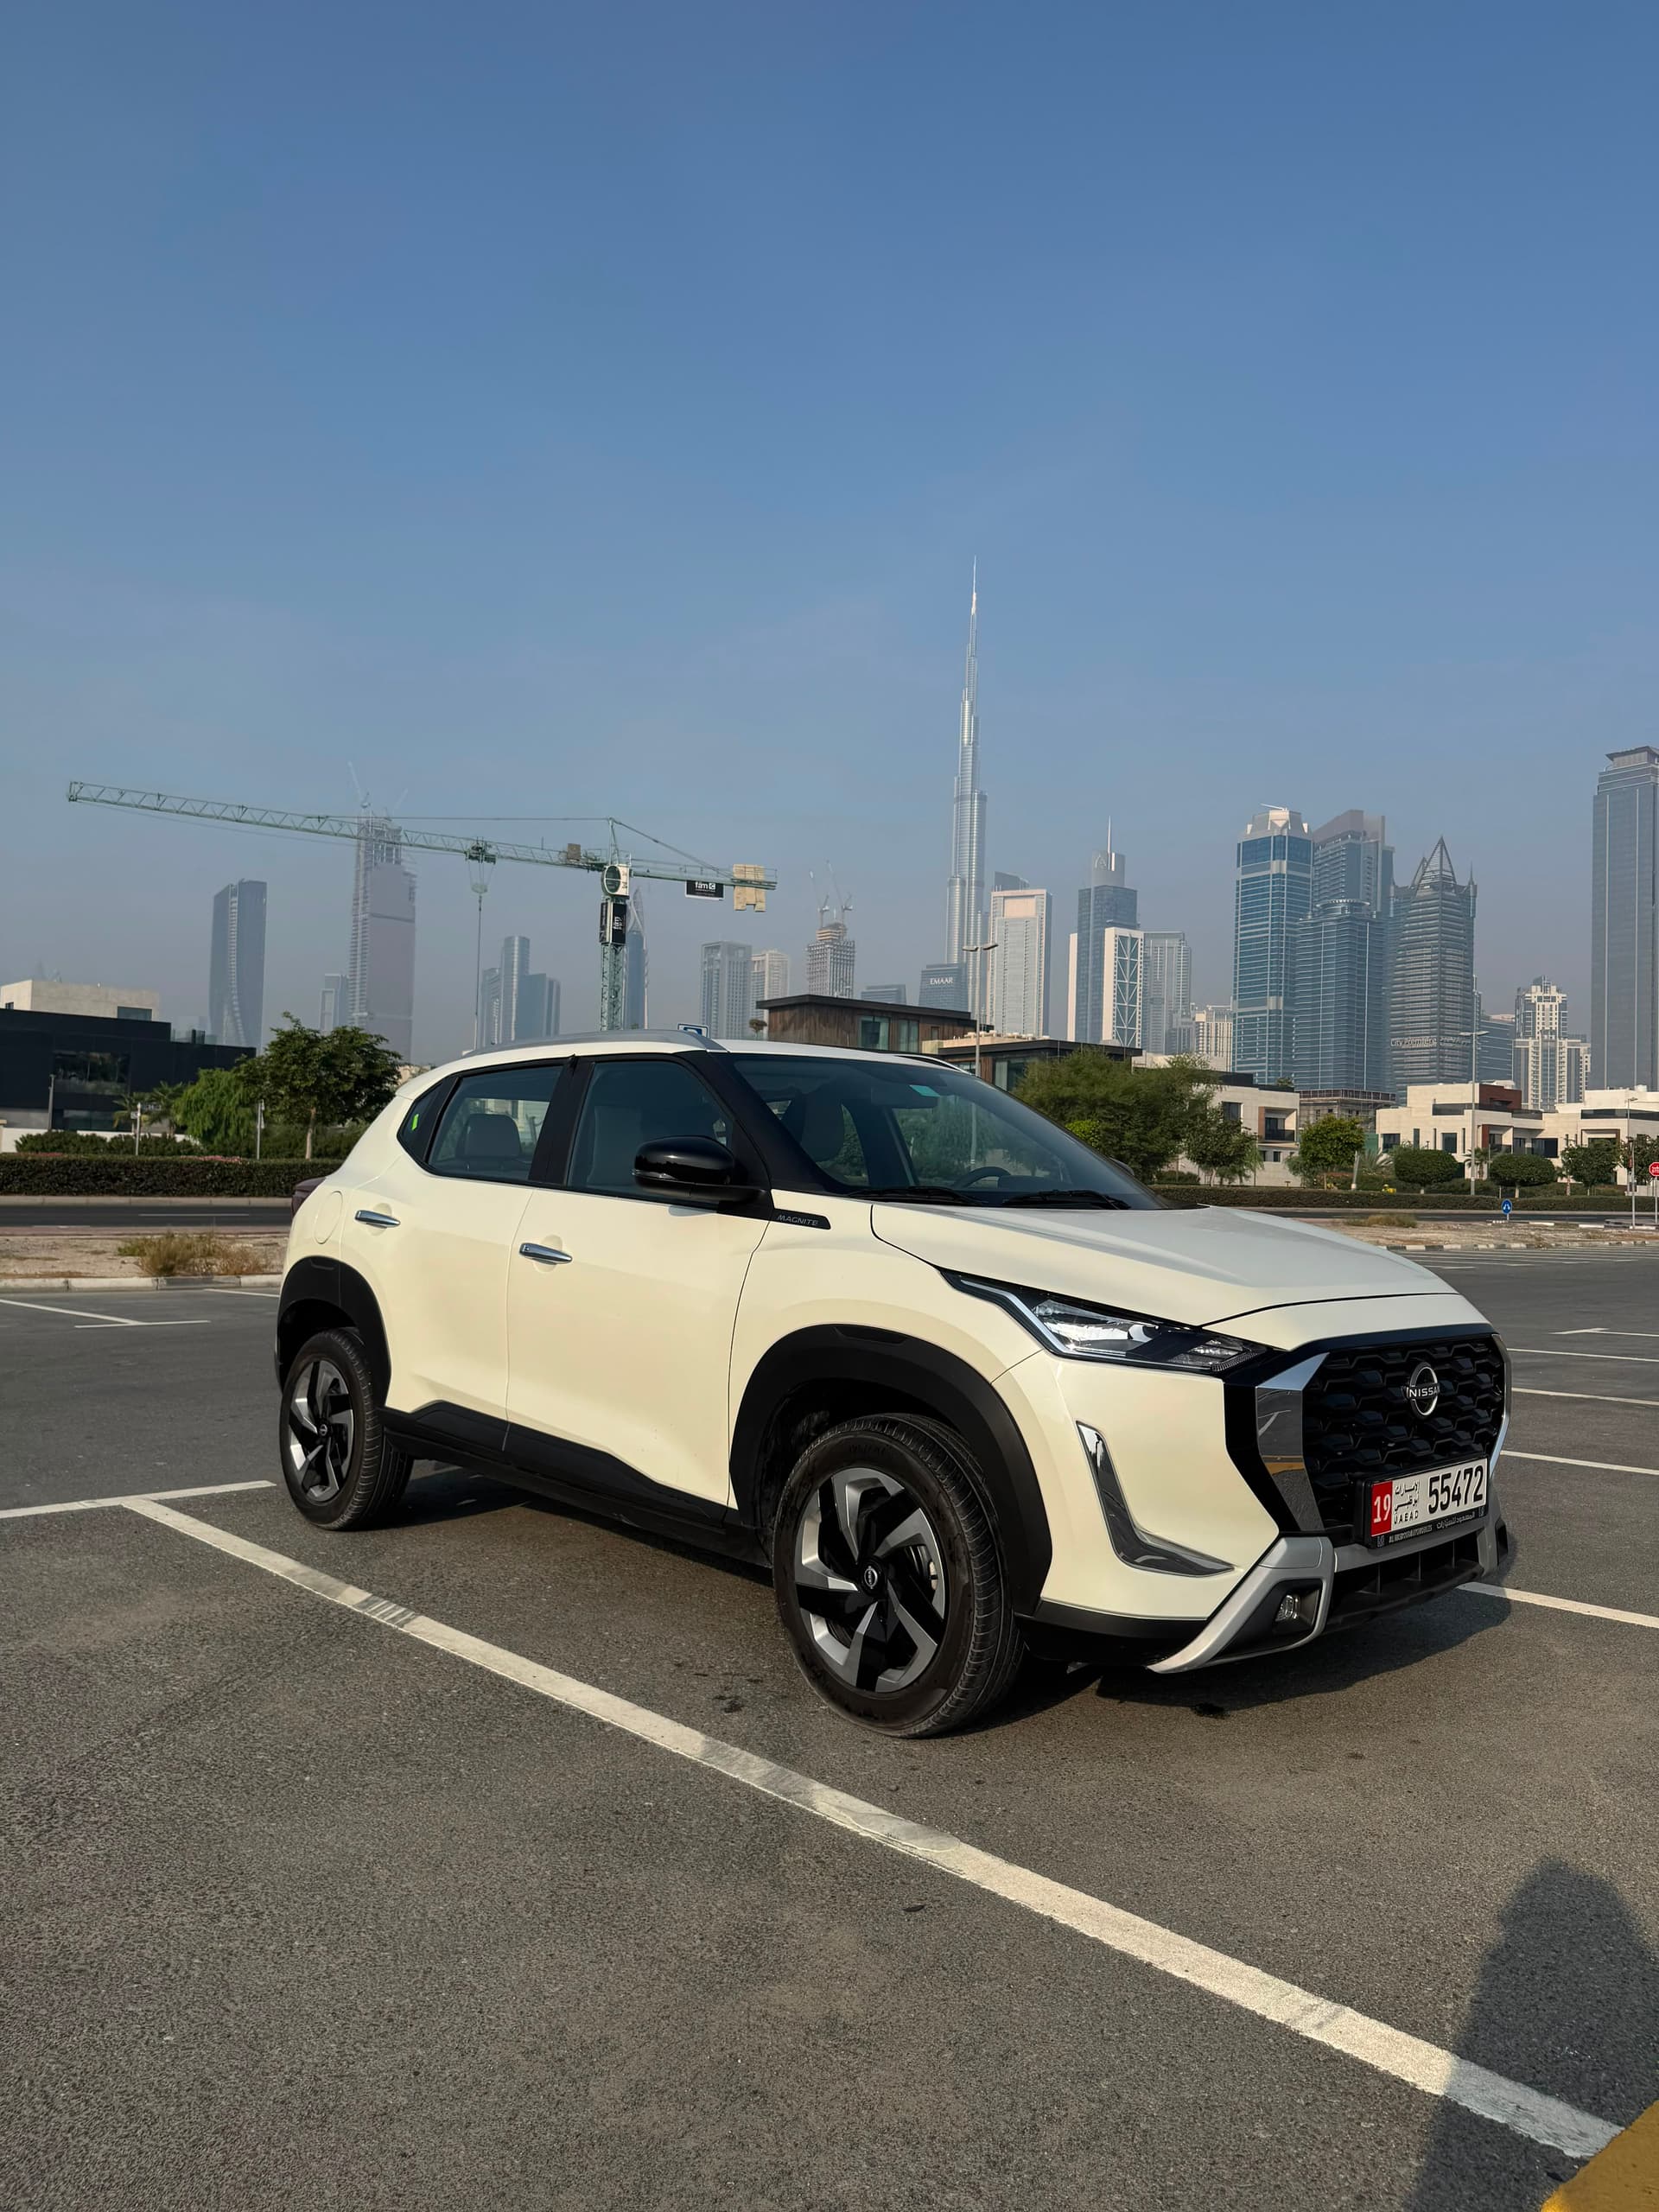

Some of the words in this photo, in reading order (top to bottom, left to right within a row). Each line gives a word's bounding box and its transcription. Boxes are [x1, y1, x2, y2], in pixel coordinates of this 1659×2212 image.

[930, 976, 954, 985] EMAAR
[778, 1214, 819, 1226] MAGNITE
[1428, 1465, 1484, 1515] 55472
[1373, 1494, 1391, 1523] 19
